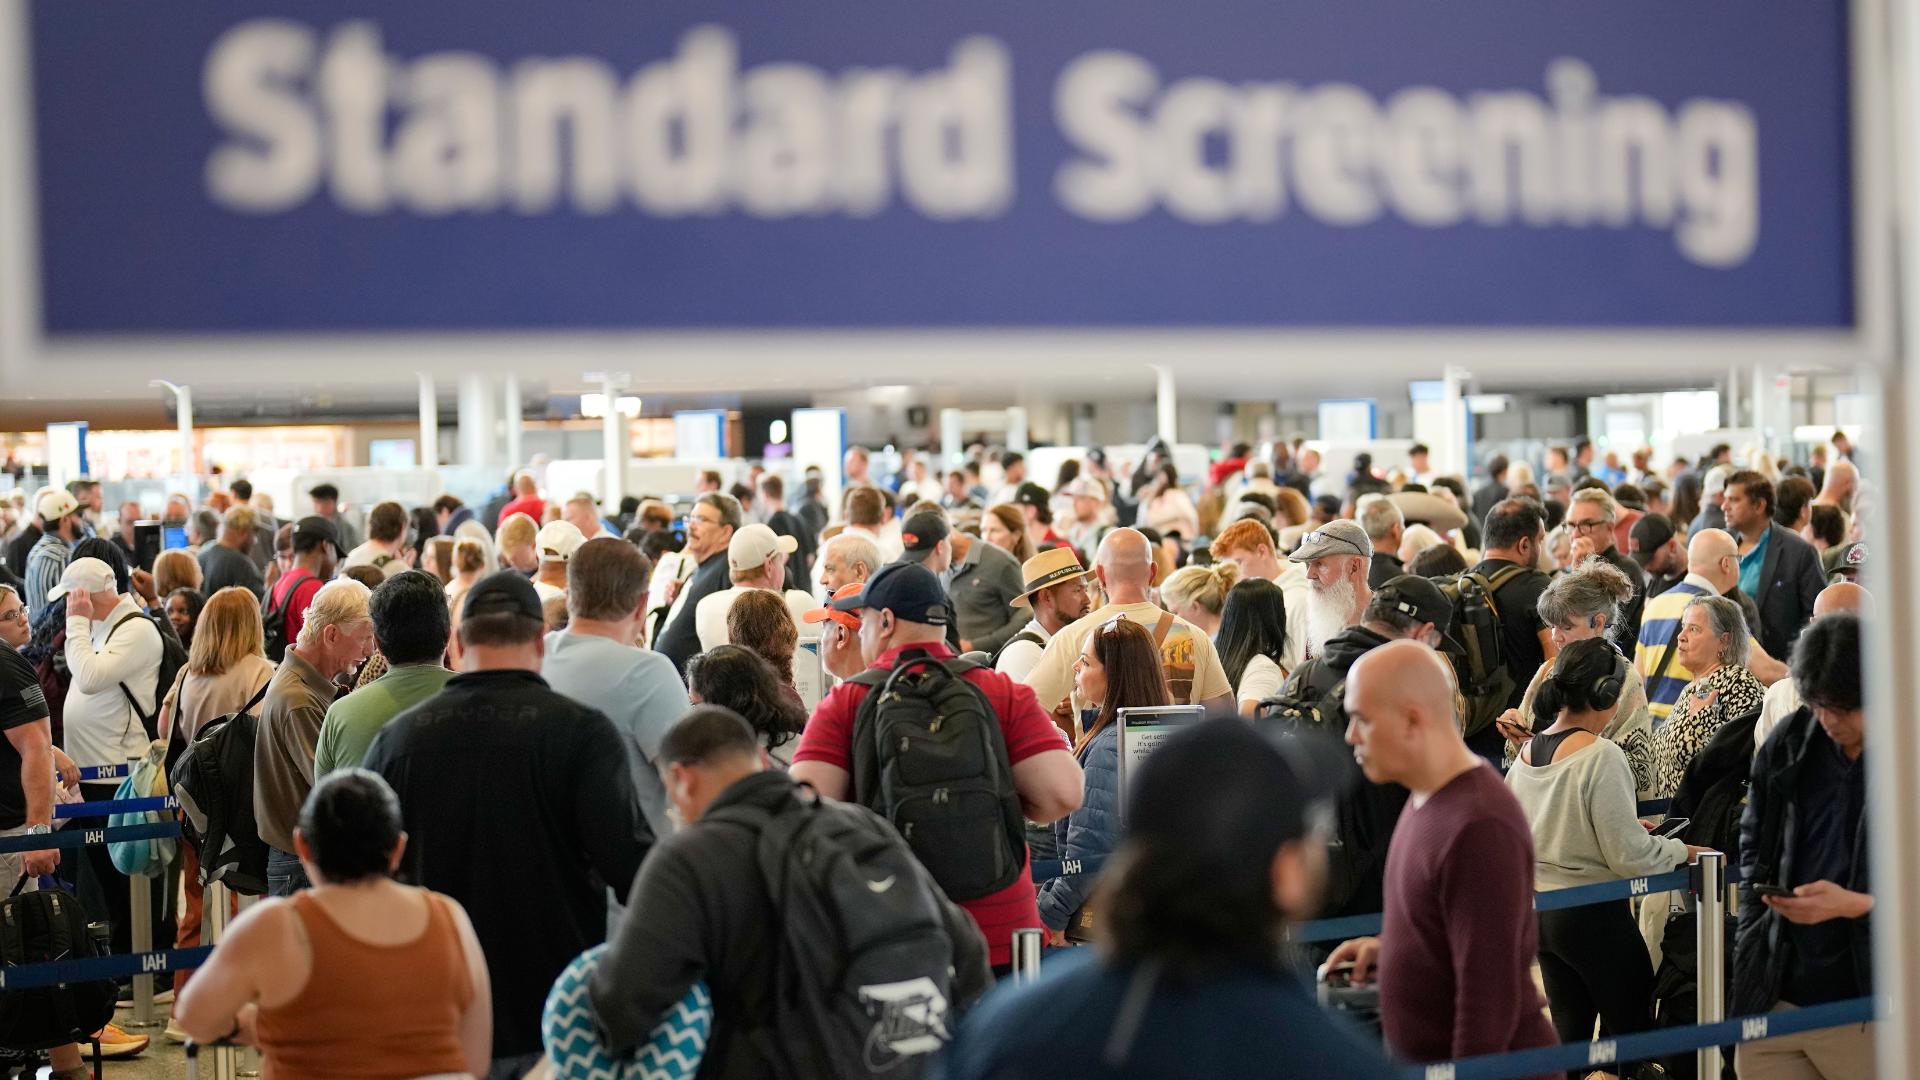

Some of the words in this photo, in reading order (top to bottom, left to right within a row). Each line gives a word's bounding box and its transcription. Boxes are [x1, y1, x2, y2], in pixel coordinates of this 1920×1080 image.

[204, 17, 1014, 218] Standard
[1053, 50, 1759, 268] Screening
[85, 830, 104, 844] IAH
[1062, 859, 1082, 875] IAH
[1630, 877, 1649, 895] IAH
[142, 953, 167, 972] IAH
[1742, 1016, 1768, 1040] IAH
[1588, 1039, 1617, 1065] IAH
